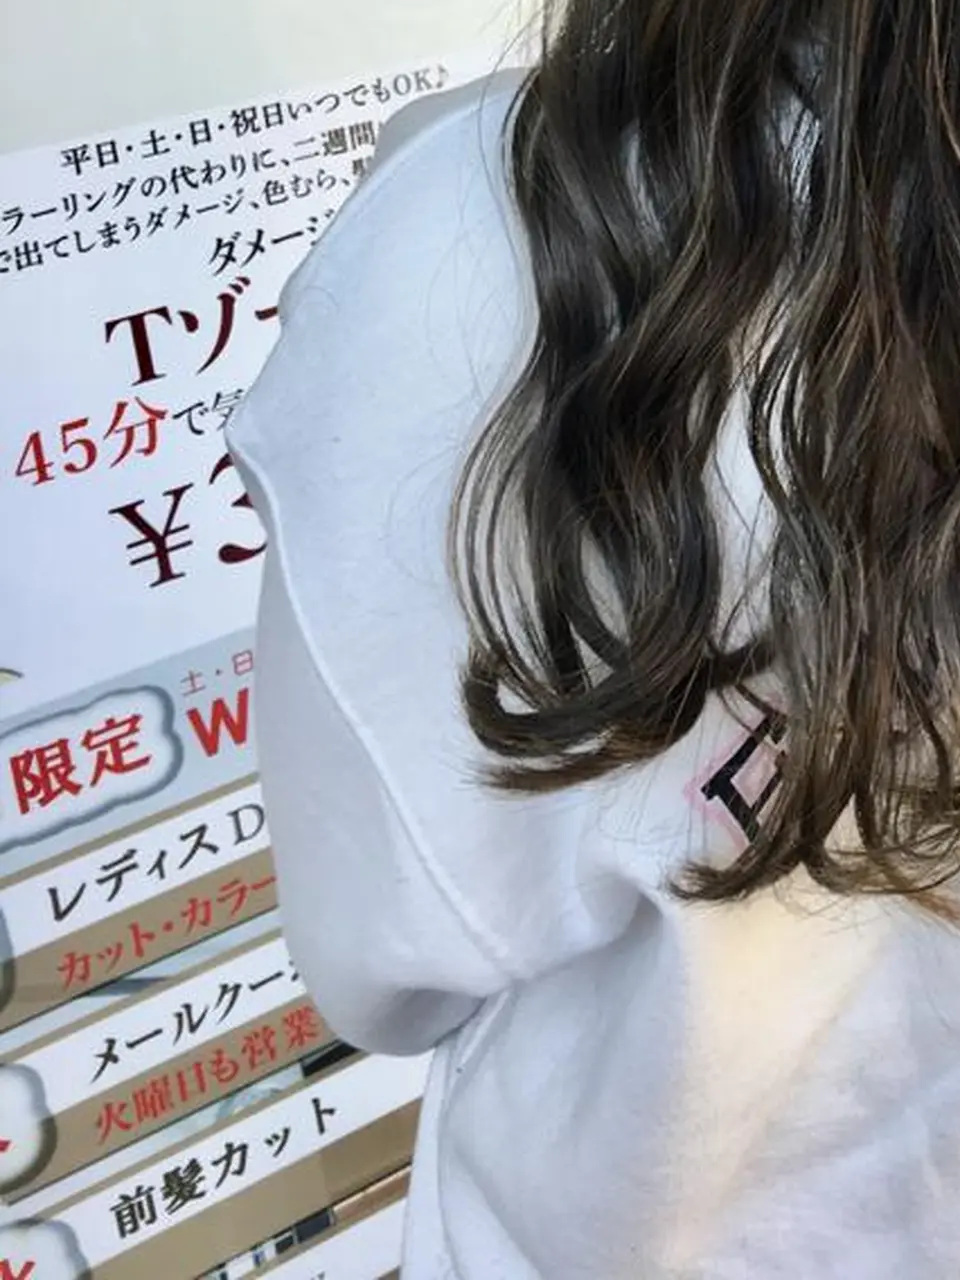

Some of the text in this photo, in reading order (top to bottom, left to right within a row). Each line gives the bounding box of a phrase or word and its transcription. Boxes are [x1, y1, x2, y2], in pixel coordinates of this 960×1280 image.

[1, 120, 382, 236] ラーリングの代わりに、二週間
[10, 713, 152, 815] 限定
[186, 687, 250, 757] W
[47, 803, 265, 923] レディスD
[90, 959, 299, 1084] メールクー
[96, 1004, 321, 1146] 火曜日も営業
[110, 1097, 336, 1238] 前髪カット
